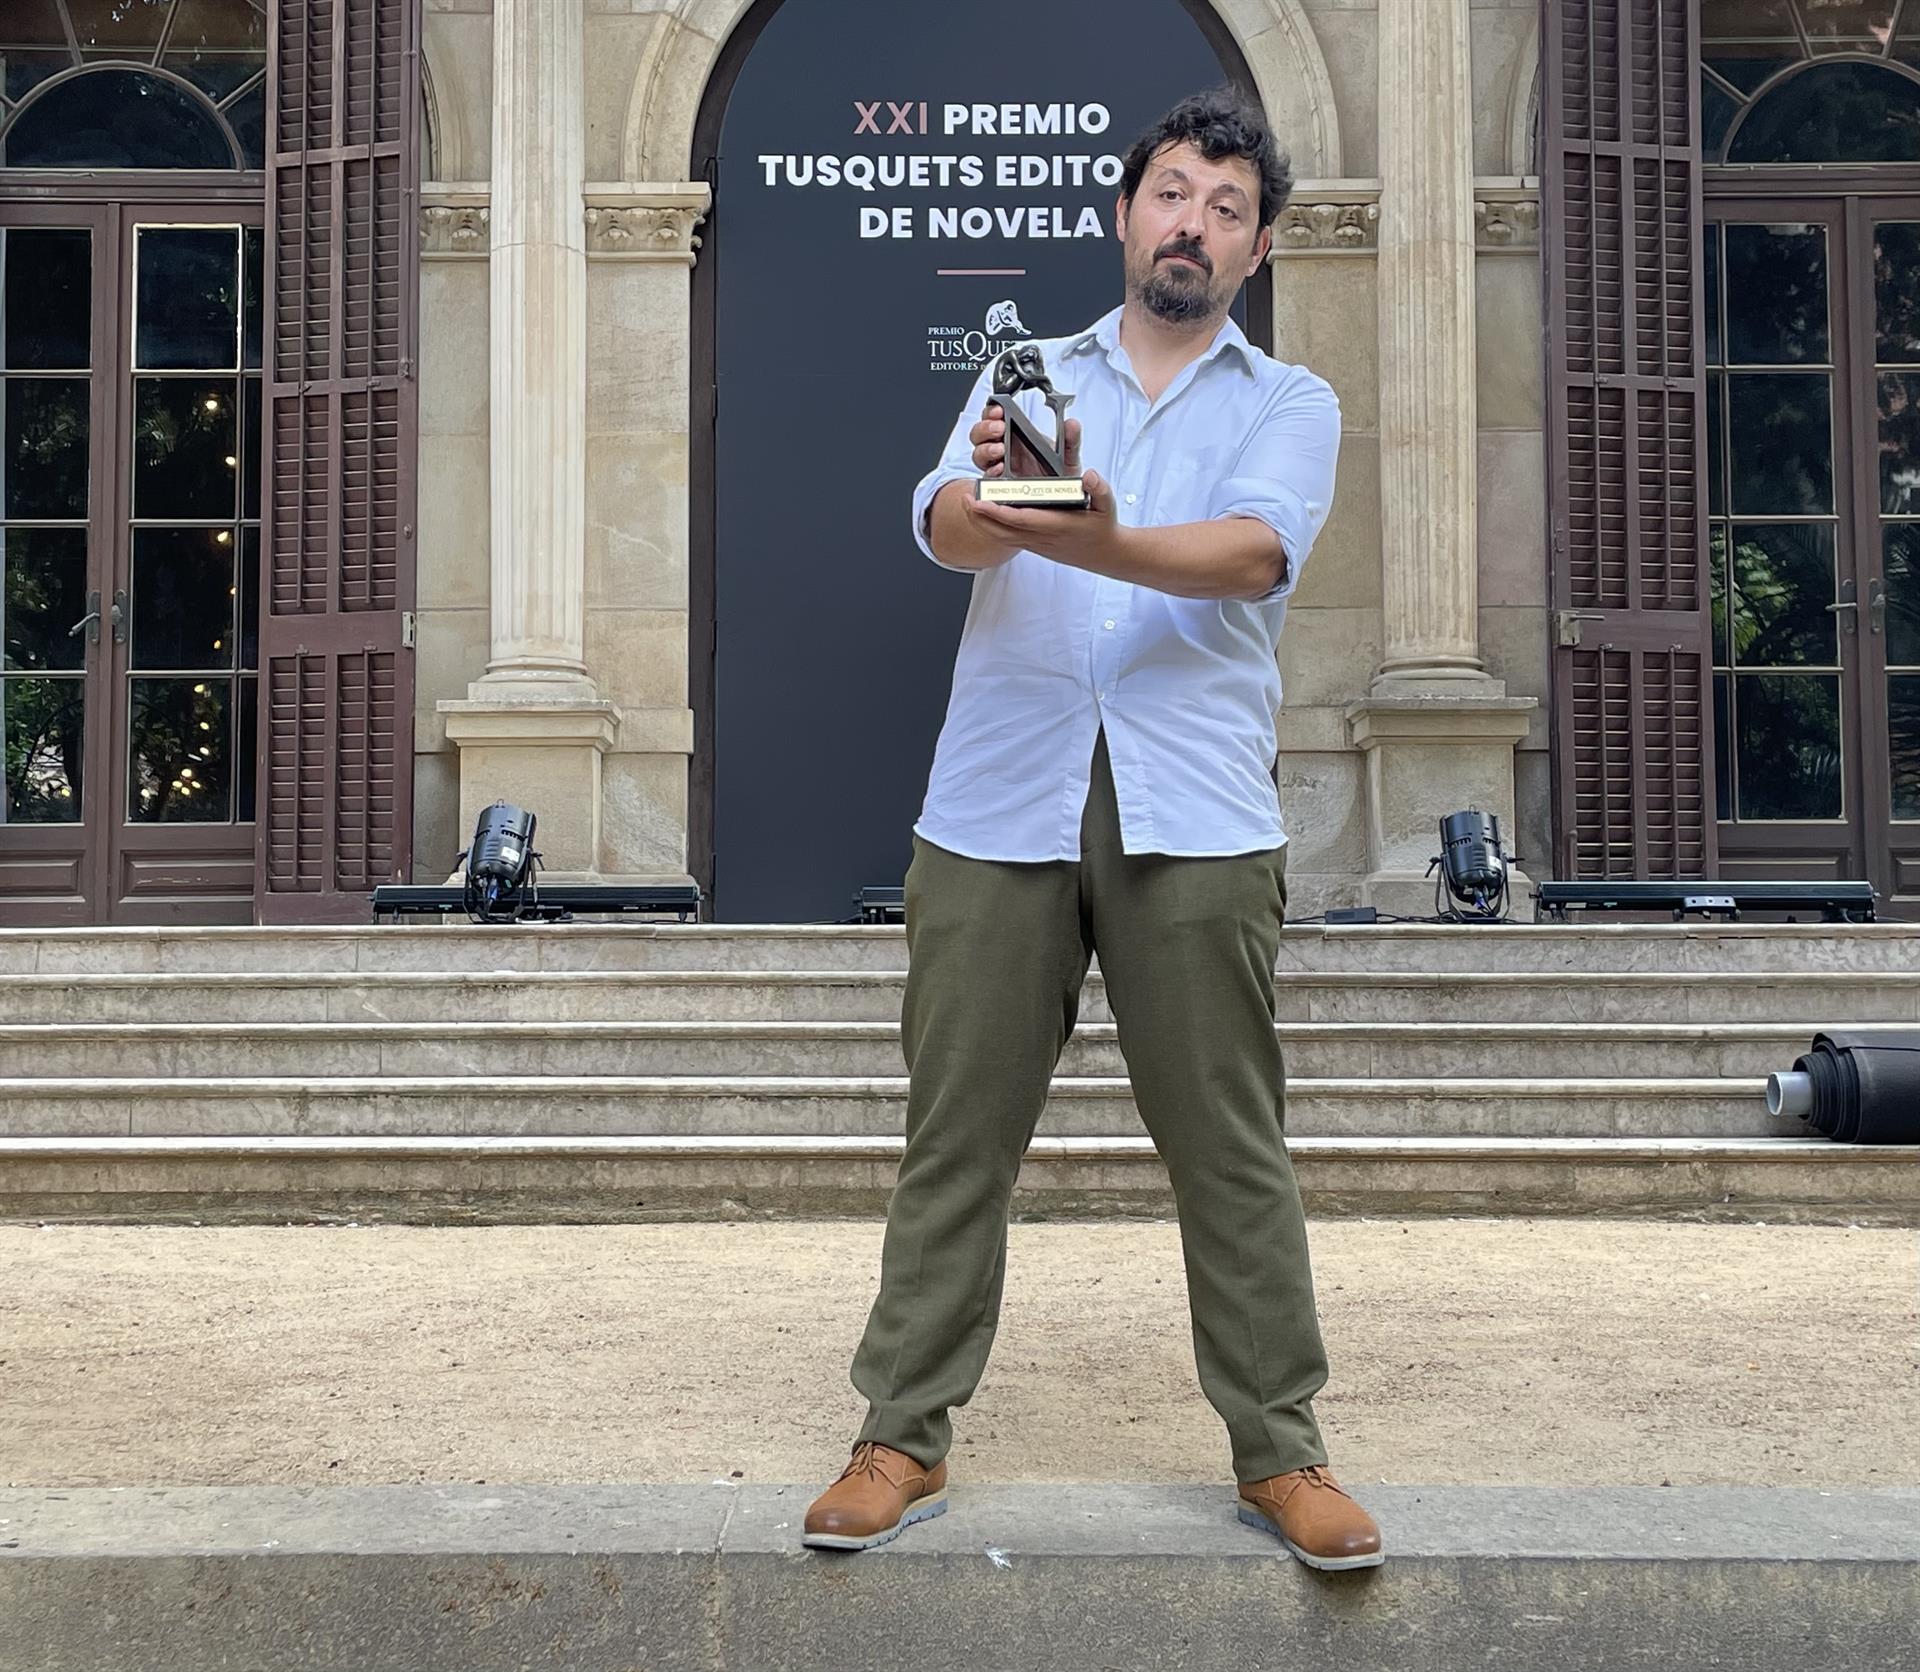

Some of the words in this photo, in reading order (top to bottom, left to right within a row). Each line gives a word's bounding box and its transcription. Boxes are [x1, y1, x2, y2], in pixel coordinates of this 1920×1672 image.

[853, 101, 928, 135] XXI
[943, 102, 1111, 135] PREMIO
[758, 154, 984, 192] TUSQUETS
[996, 153, 1124, 187] EDITO
[860, 206, 913, 239] DE
[928, 206, 1105, 239] NOVELA
[927, 326, 965, 336] PREMIO
[927, 331, 1015, 362] TUSQUE
[930, 362, 978, 371] EDITORES
